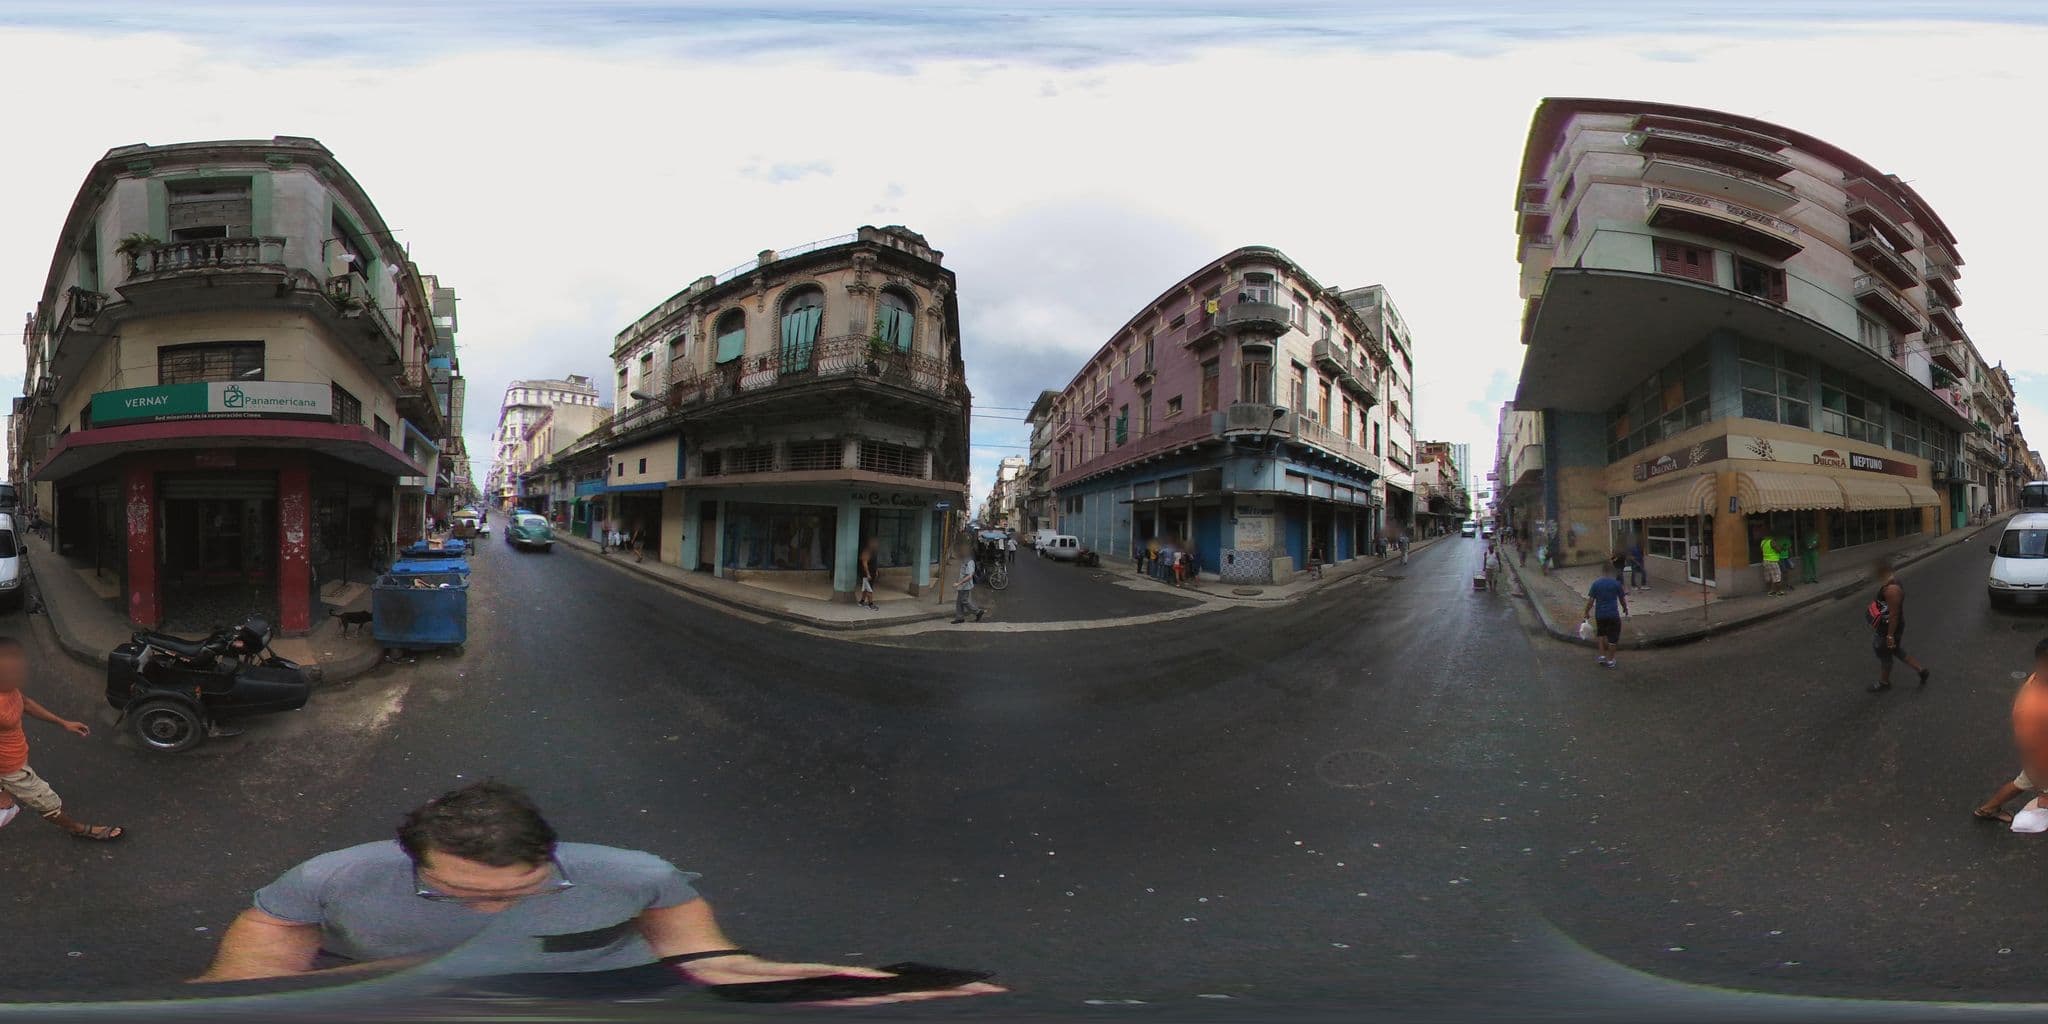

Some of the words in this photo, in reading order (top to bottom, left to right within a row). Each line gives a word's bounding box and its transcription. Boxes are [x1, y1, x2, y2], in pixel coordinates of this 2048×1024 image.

[125, 395, 169, 408] VERNAY
[245, 396, 316, 407] Panamericana
[1852, 455, 1882, 470] NEPTUNO
